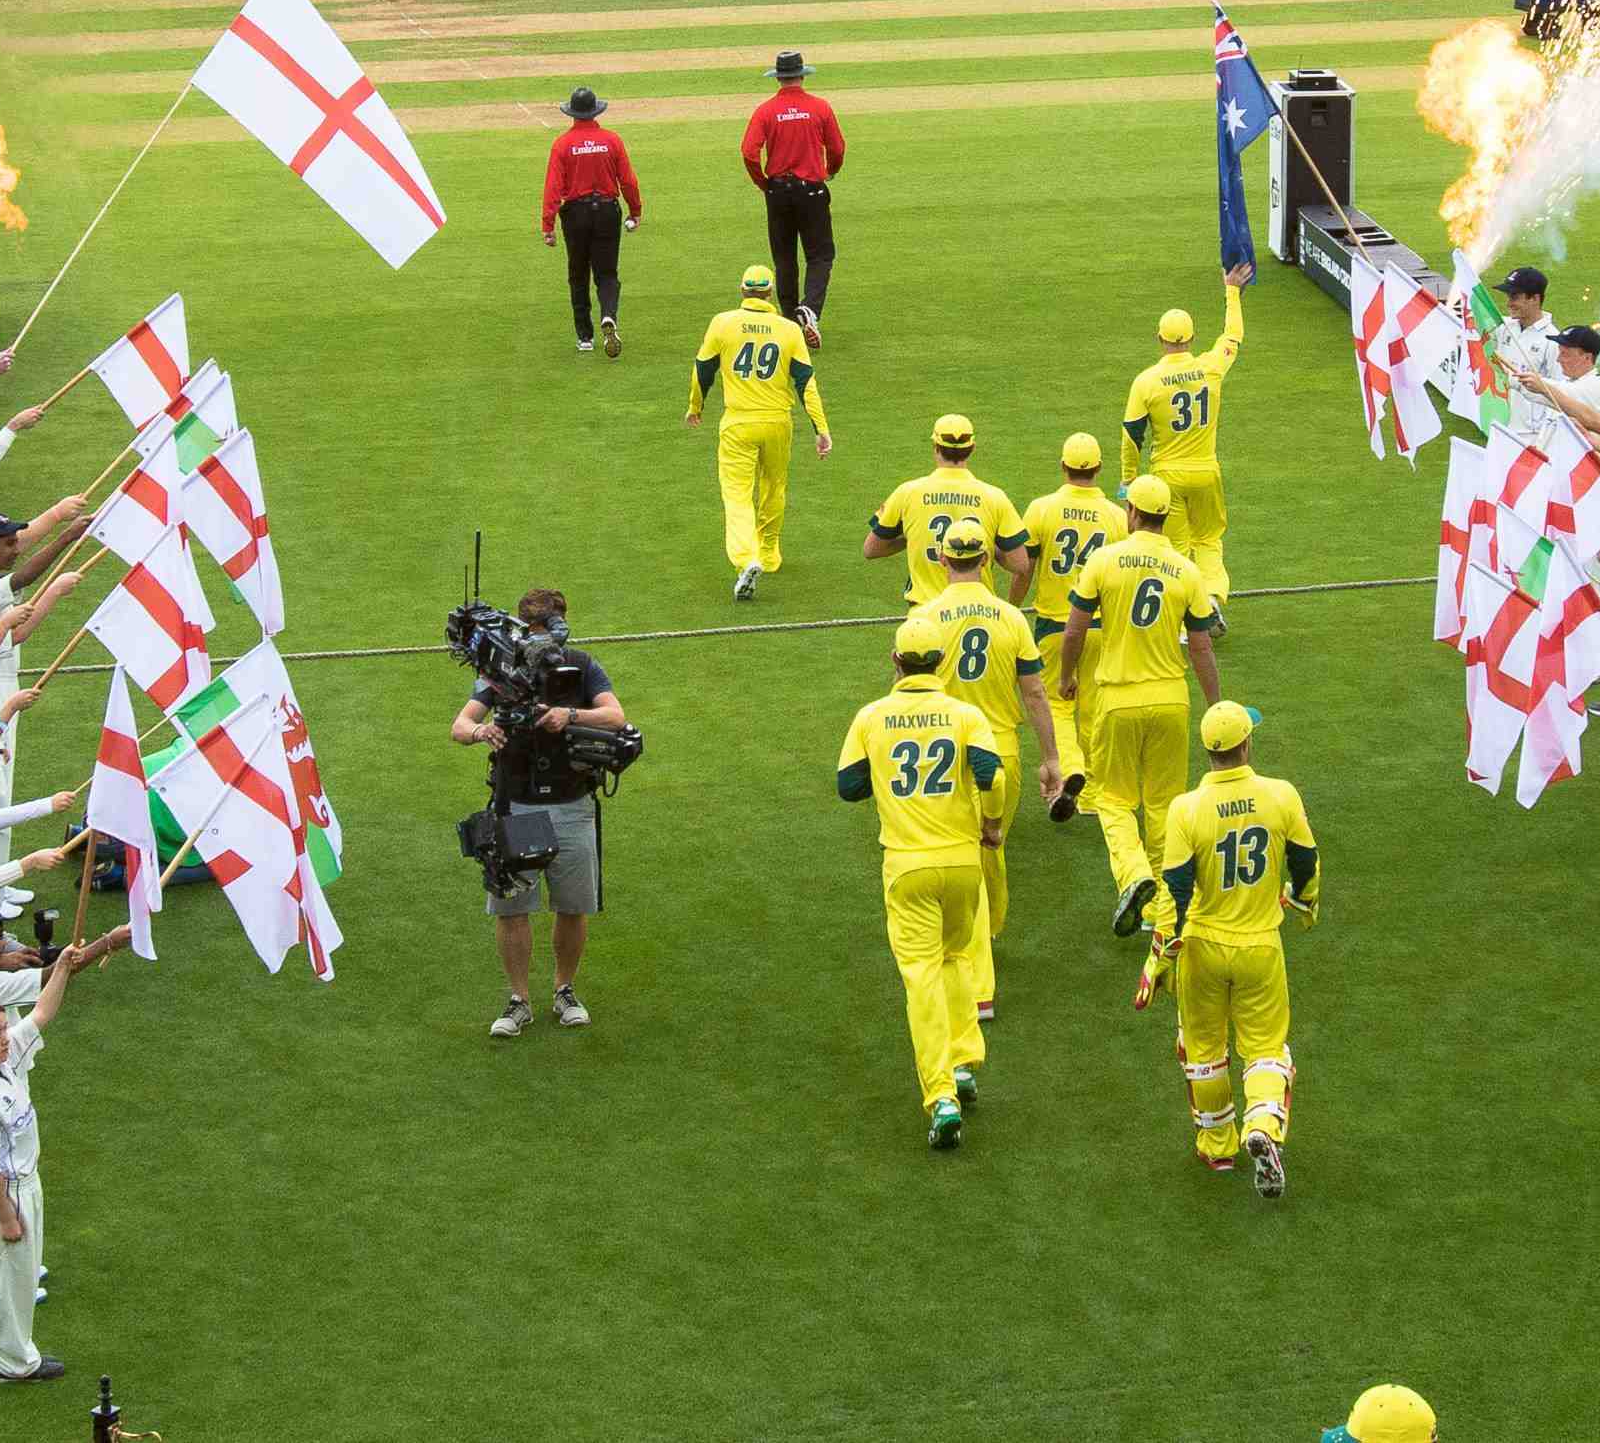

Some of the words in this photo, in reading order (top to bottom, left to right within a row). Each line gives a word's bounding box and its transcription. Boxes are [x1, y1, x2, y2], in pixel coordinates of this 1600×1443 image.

[572, 143, 608, 155] Emirates
[742, 324, 772, 334] SMITH
[733, 341, 780, 380] 49
[1161, 370, 1205, 386] WARNER
[1171, 385, 1210, 433] 31
[922, 492, 982, 508] CUMMINS
[1063, 507, 1100, 523] BOYCE
[926, 515, 980, 562] 3
[1051, 528, 1106, 575] 34
[940, 604, 1001, 623] M.MARSH
[1131, 577, 1165, 628] 6
[956, 626, 990, 682] 8
[884, 713, 952, 730] MAXWELL
[890, 737, 958, 799] 32
[1216, 797, 1257, 819] WADE
[1214, 823, 1270, 892] 13
